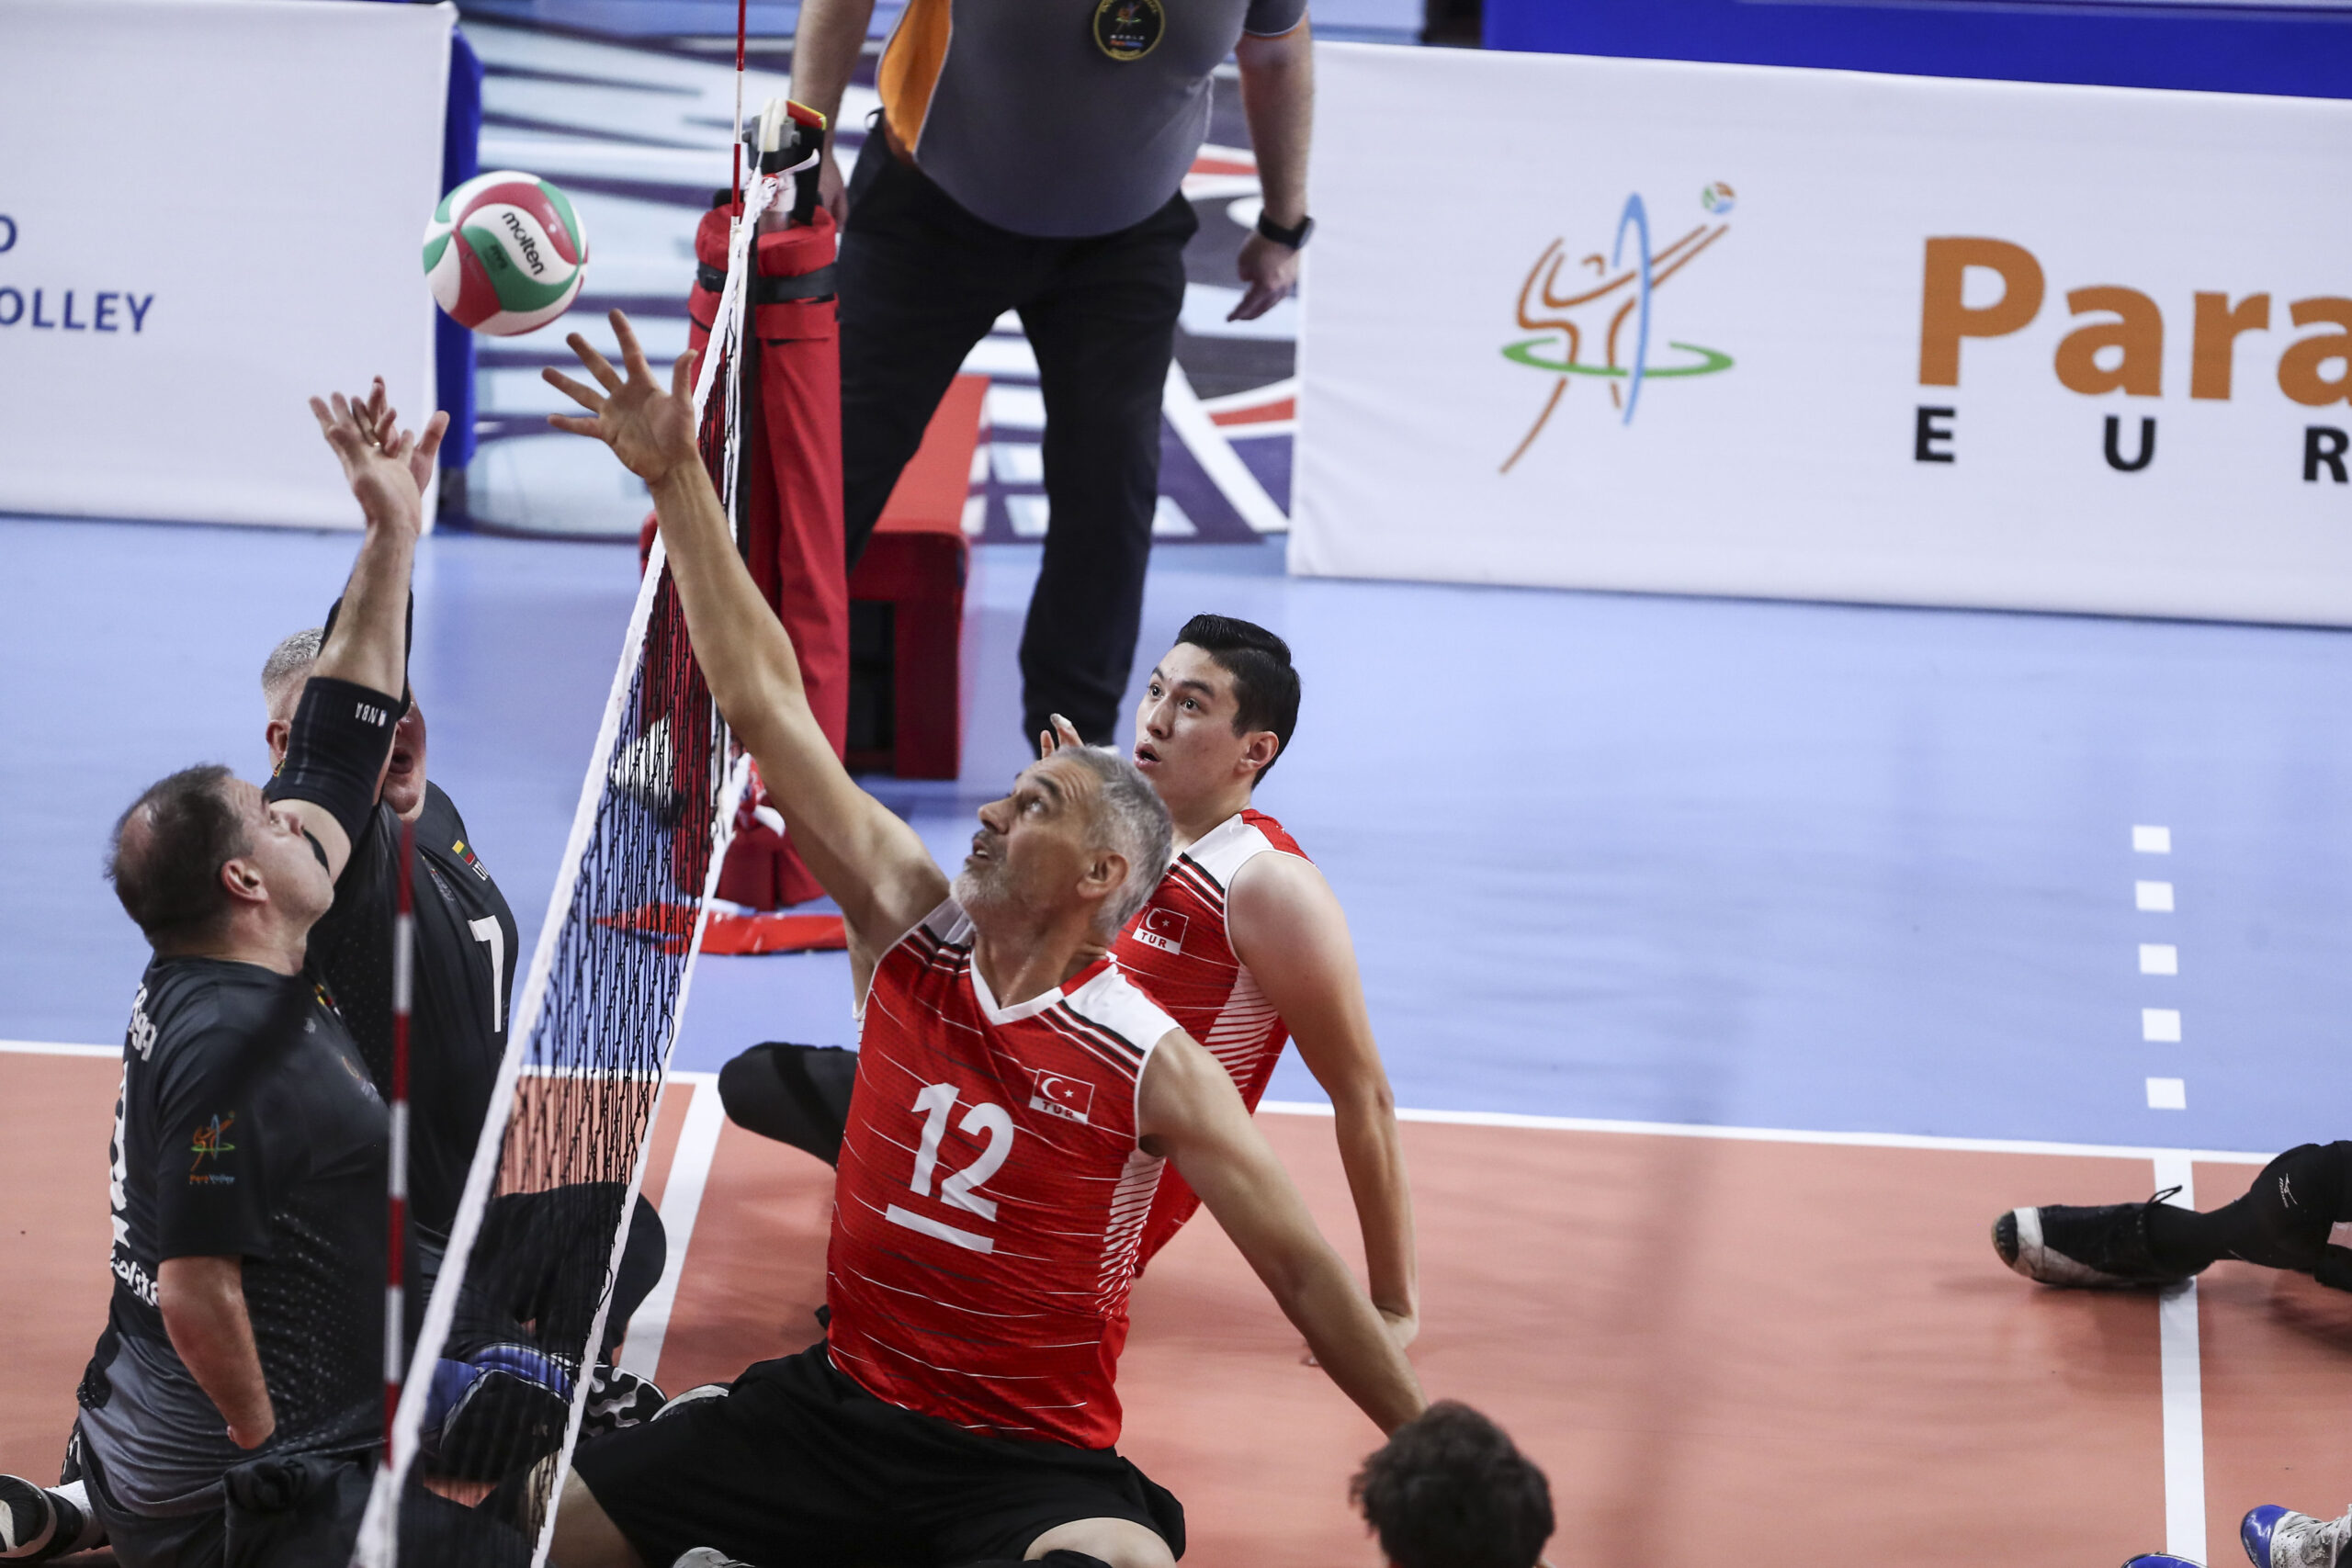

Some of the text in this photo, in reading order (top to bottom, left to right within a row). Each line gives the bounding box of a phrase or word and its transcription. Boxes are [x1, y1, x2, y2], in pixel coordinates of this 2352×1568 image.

[502, 211, 545, 276] molten
[0, 285, 155, 333] OLLEY
[1918, 234, 2352, 407] Para
[1141, 931, 1167, 949] TUR
[1042, 1100, 1075, 1119] TUR
[910, 1081, 1015, 1223] 12
